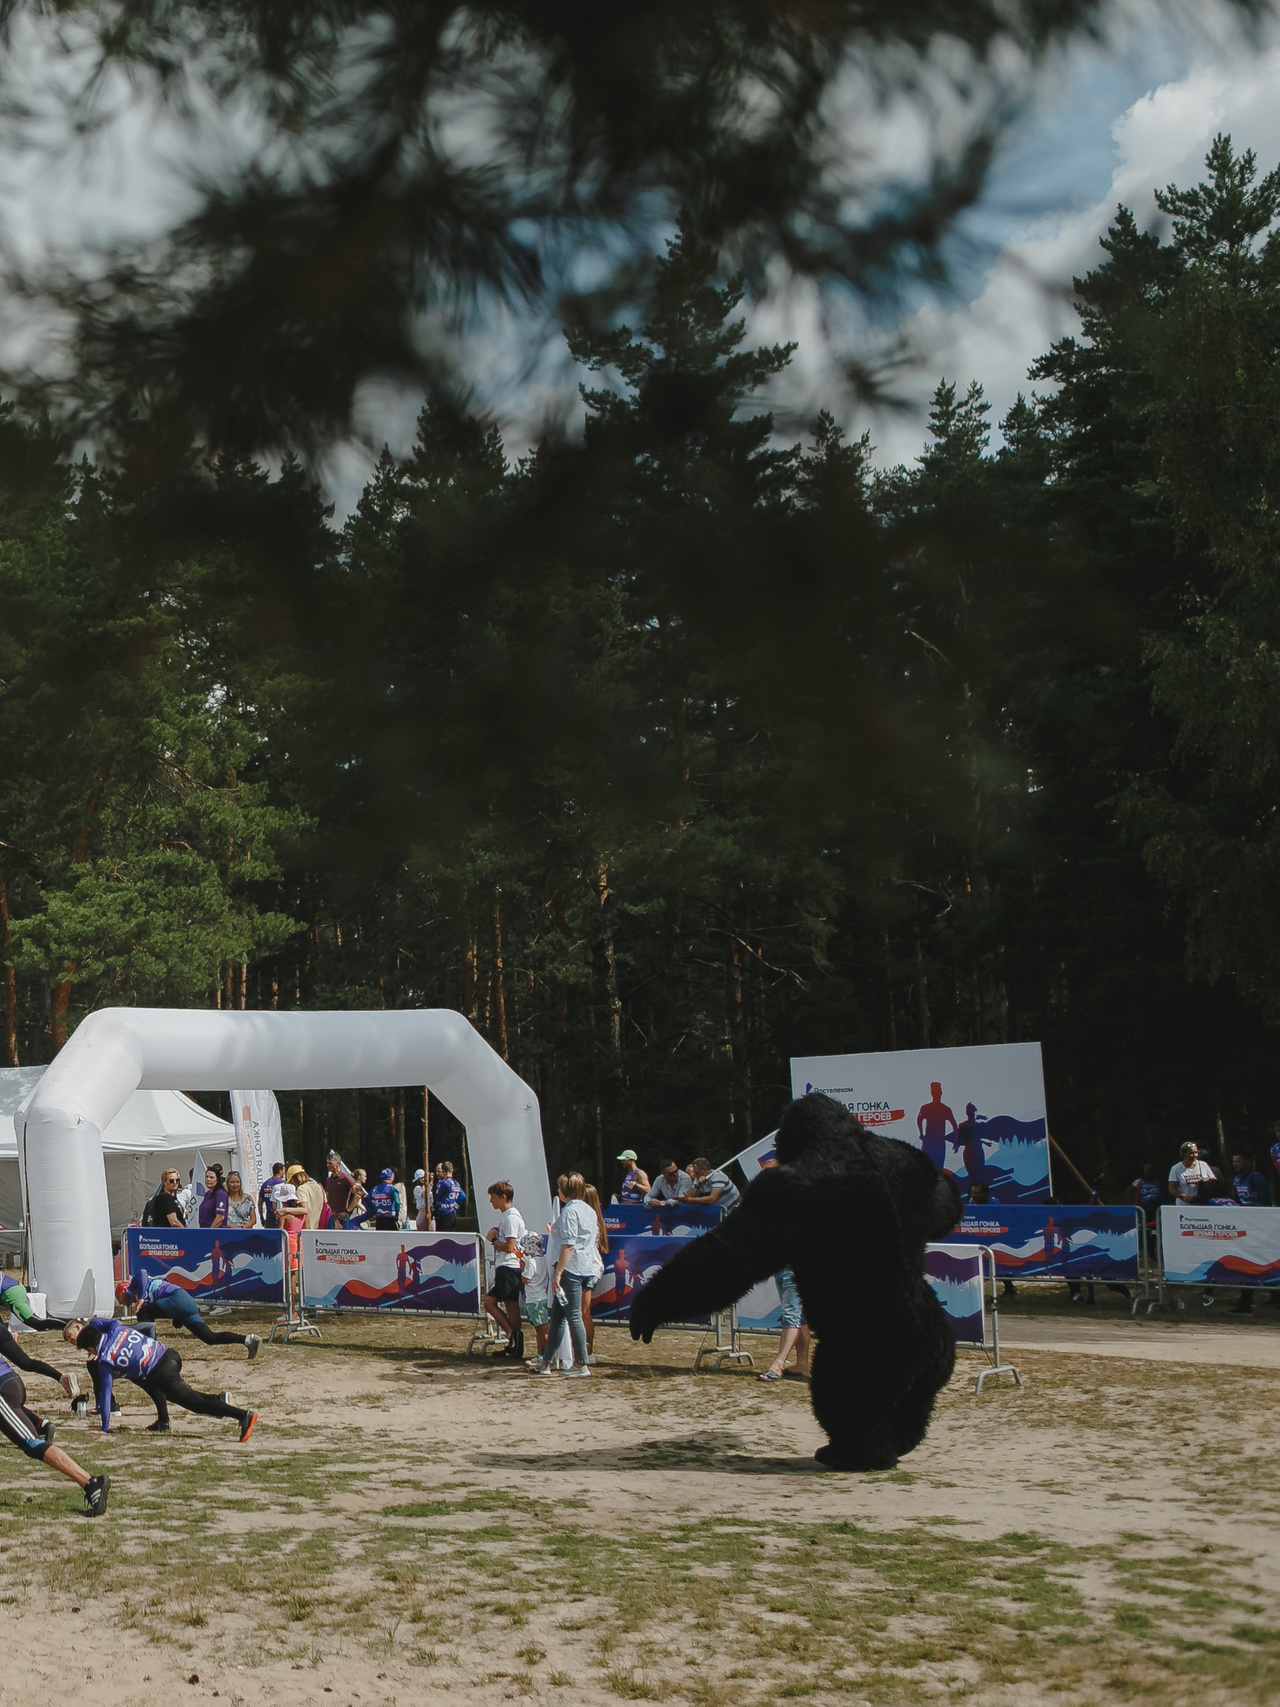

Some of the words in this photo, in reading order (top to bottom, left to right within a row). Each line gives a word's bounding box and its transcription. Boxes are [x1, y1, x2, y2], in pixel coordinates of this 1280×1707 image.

[857, 1101, 890, 1111] ГОНКА
[857, 1112, 892, 1121] ГЕРОЕВ
[117, 1330, 144, 1366] 02-07
